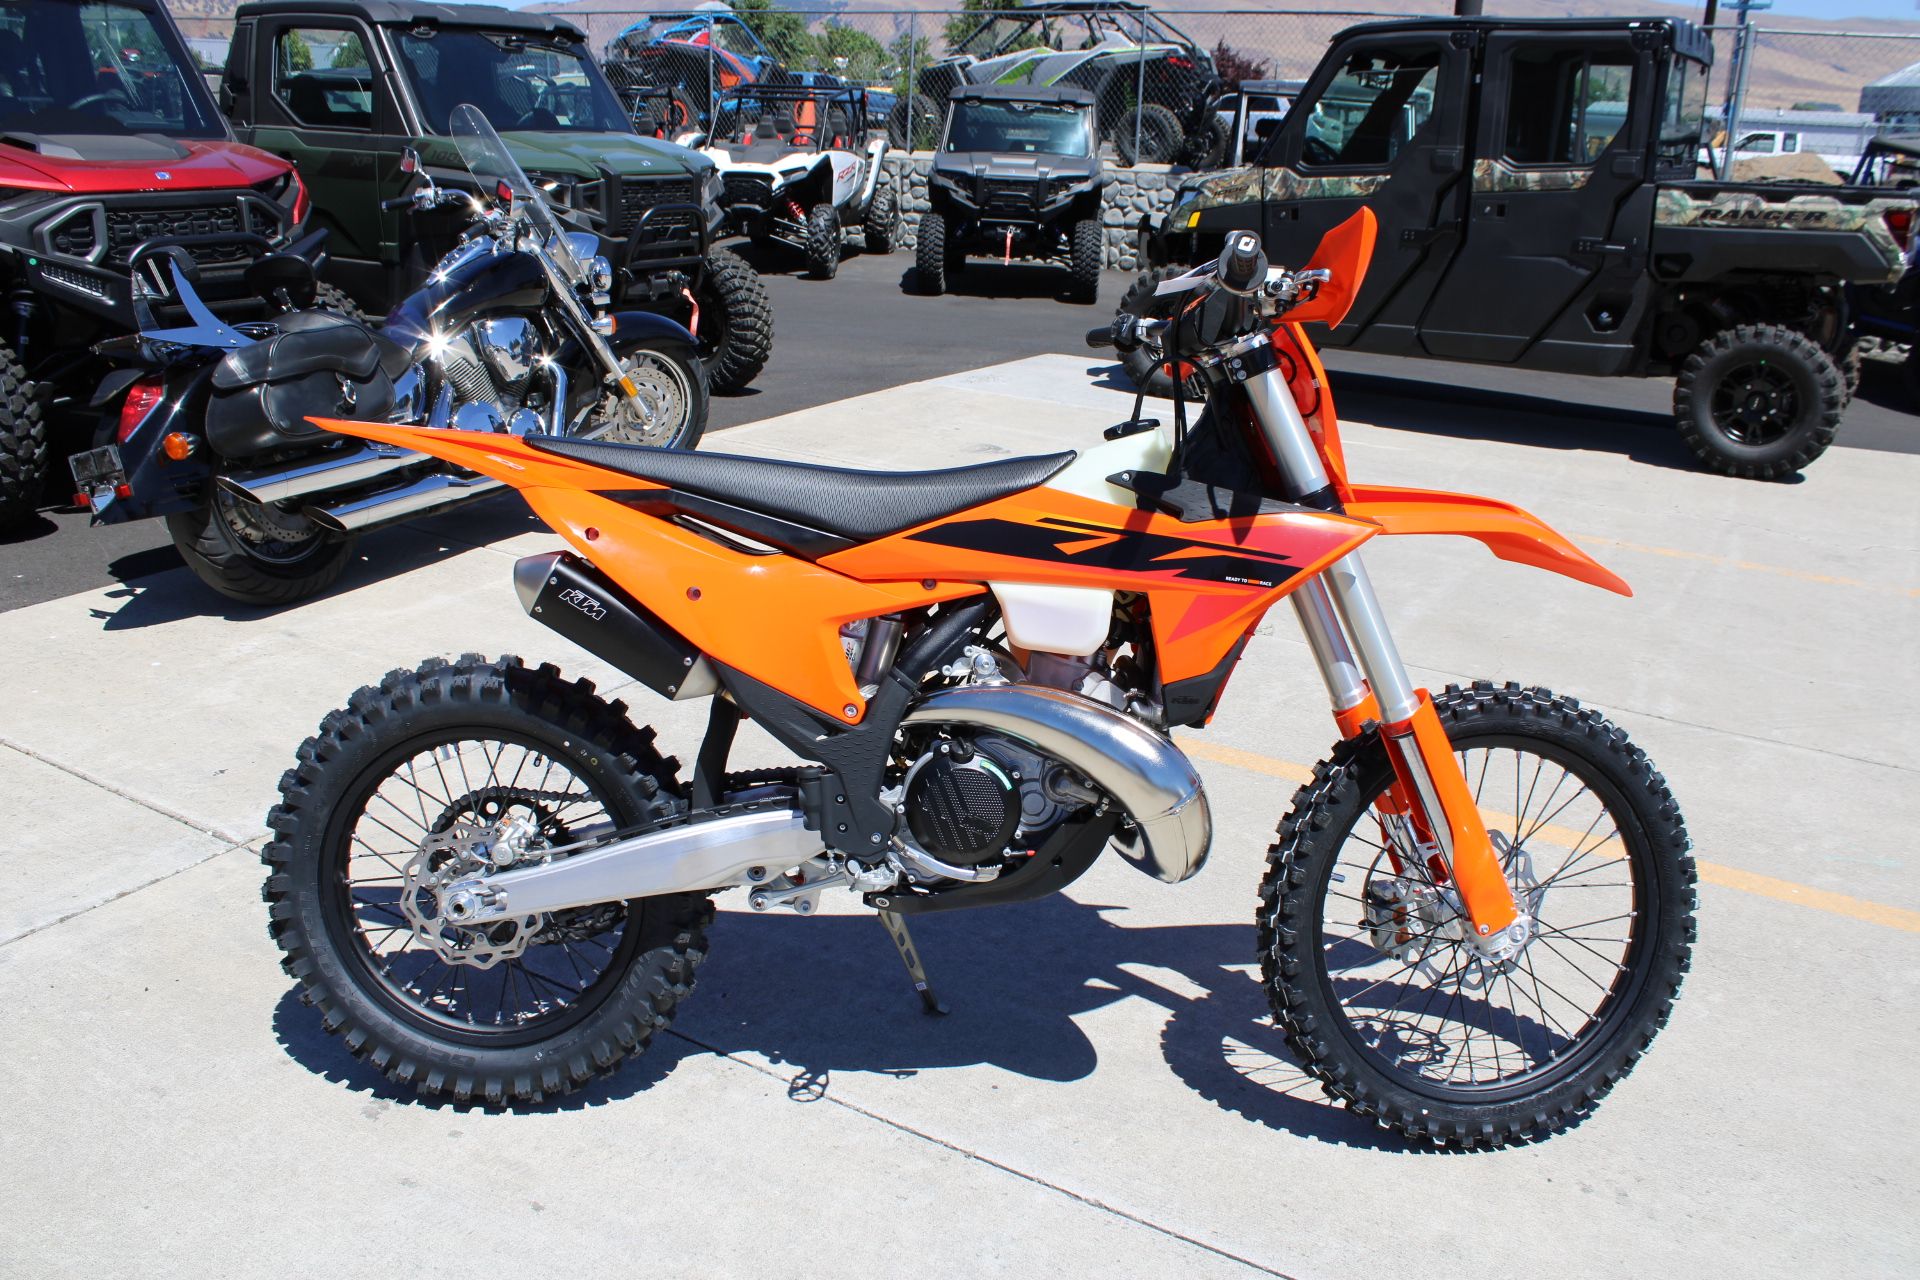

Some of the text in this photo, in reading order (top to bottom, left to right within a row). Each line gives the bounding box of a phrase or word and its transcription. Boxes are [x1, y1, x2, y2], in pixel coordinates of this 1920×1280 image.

[1699, 208, 1828, 222] RANGER
[113, 217, 238, 242] POLARIS
[558, 588, 607, 621] KTM
